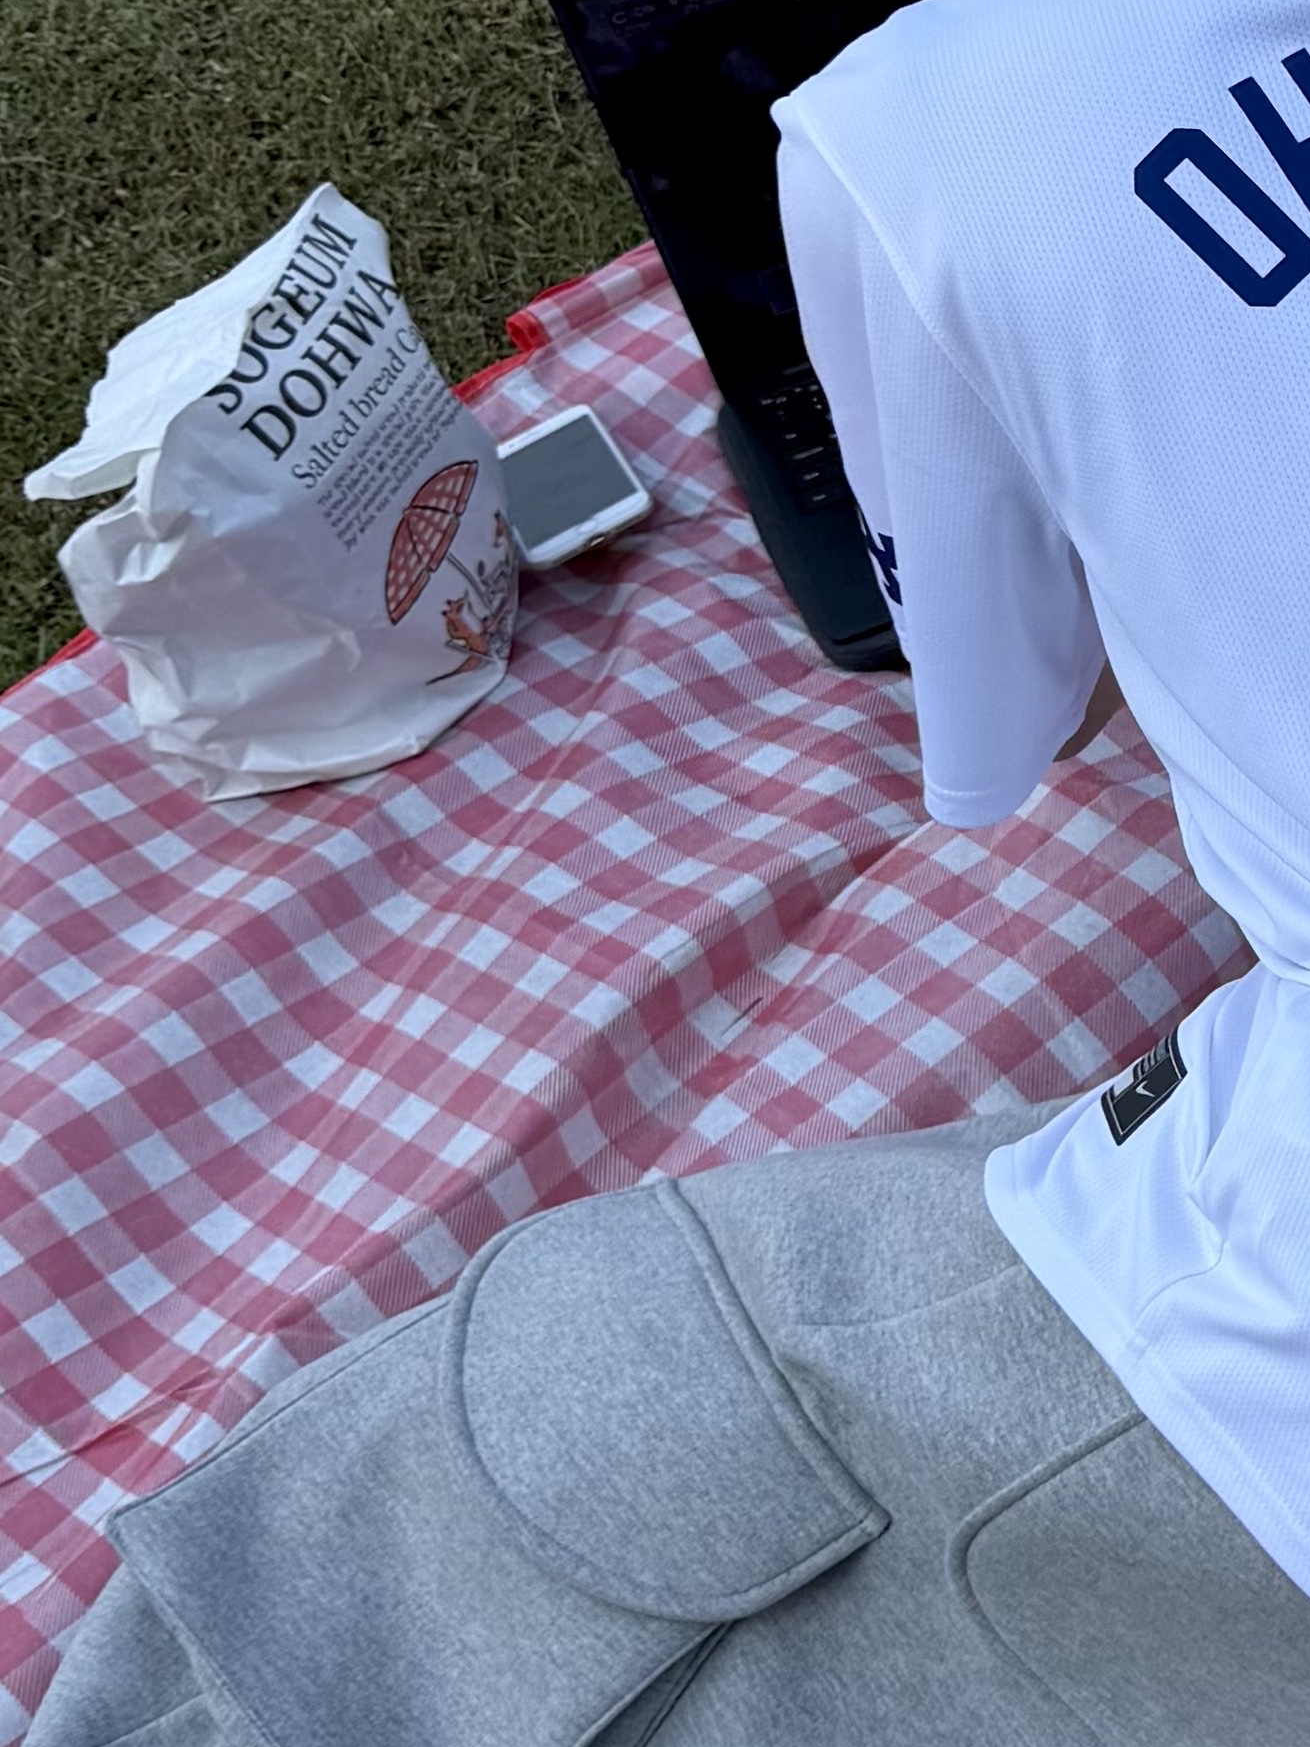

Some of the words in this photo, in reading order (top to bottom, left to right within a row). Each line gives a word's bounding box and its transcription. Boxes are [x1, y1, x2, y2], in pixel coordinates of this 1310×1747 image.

[240, 270, 401, 462] DOHWA
[292, 410, 360, 489] Salted
[350, 347, 406, 418] bread
